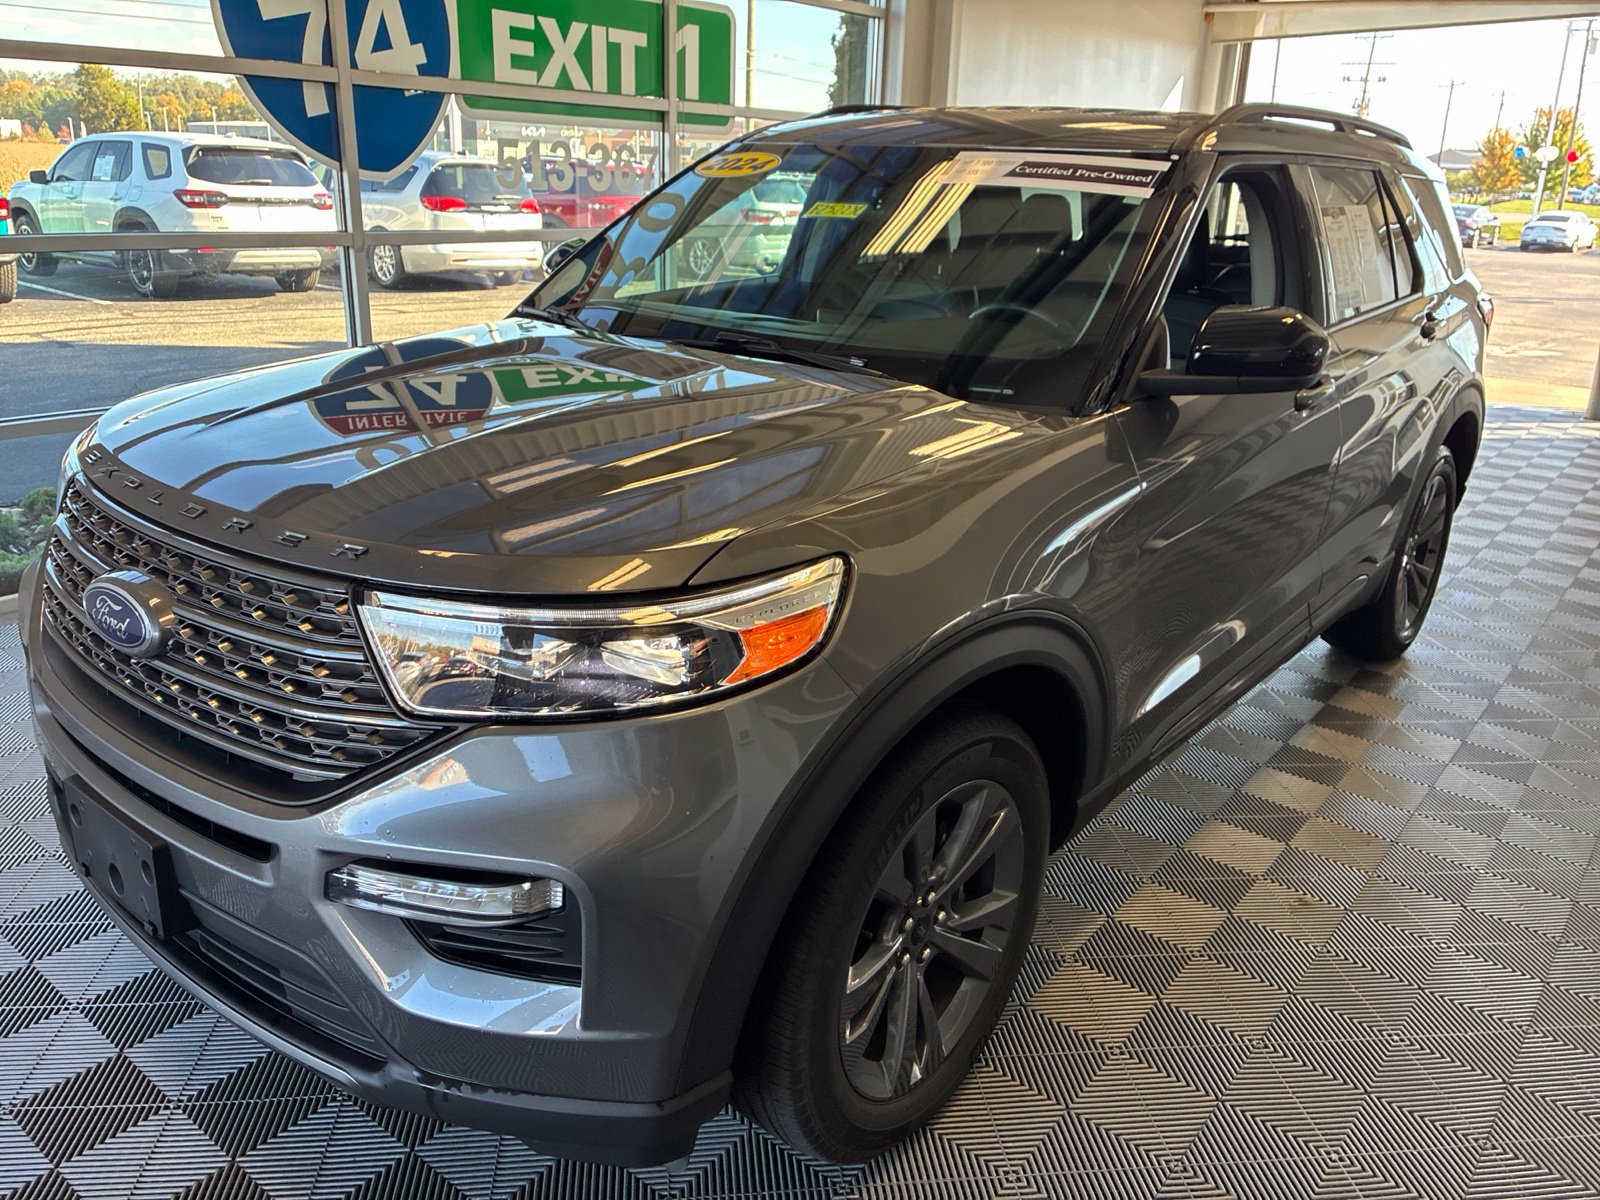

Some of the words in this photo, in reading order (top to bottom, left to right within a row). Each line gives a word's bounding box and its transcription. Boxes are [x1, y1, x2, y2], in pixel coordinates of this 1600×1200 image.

[259, 0, 428, 118] 74
[491, 8, 648, 96] EXIT
[676, 24, 700, 100] 1
[700, 156, 777, 172] 2024
[1015, 165, 1071, 178] Certified
[1075, 168, 1153, 184] Pre-Owned
[85, 450, 369, 560] EXPLORER
[92, 595, 130, 639] Ford
[735, 590, 824, 624] EXPLORER
